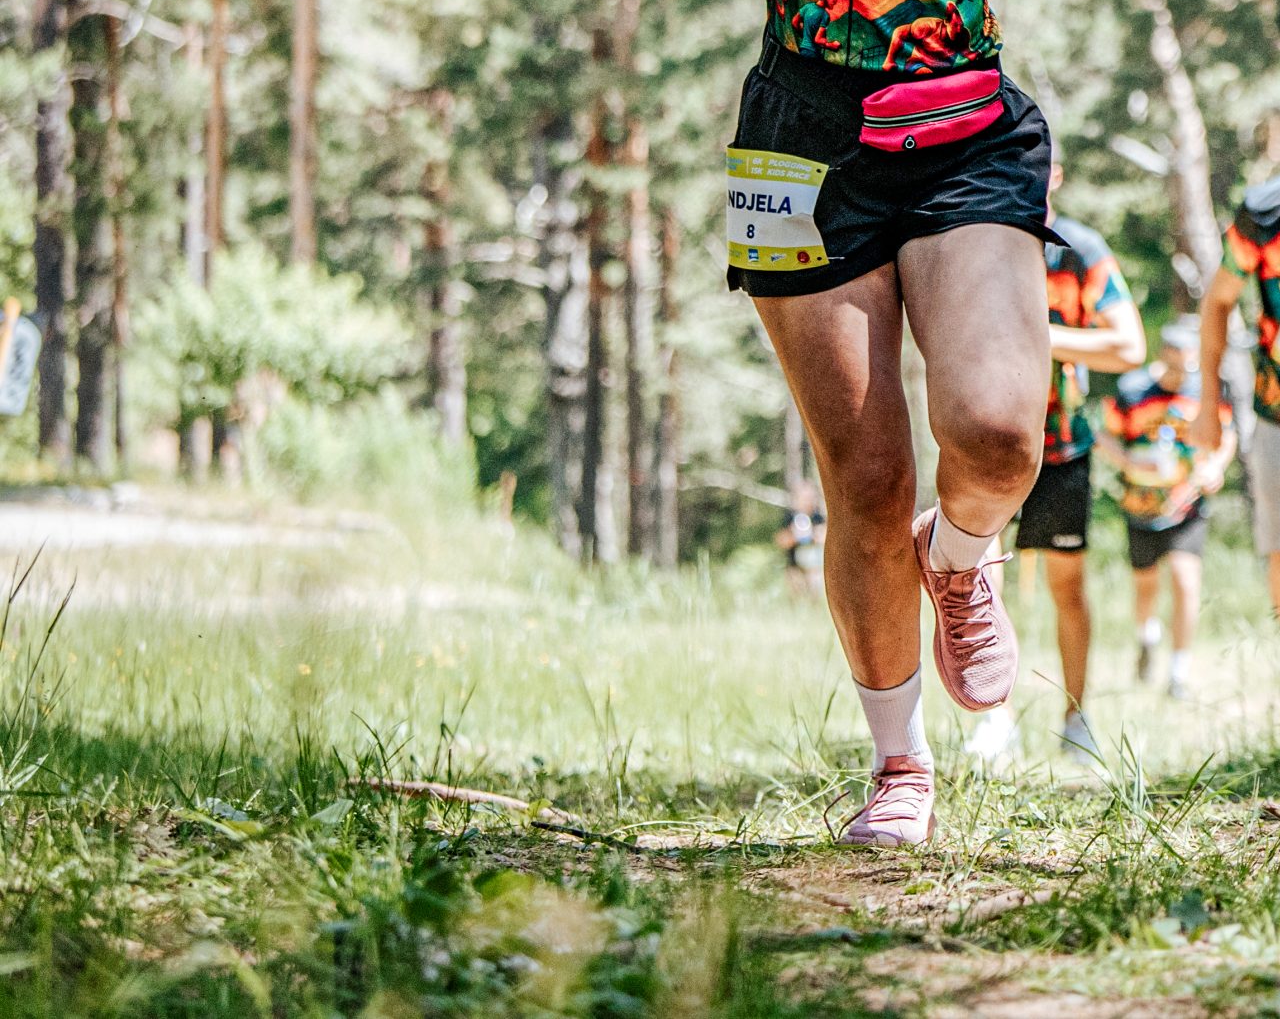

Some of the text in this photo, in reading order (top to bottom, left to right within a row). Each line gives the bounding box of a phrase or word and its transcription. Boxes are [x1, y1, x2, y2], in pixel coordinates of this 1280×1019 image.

[768, 158, 812, 172] PLOGGING
[767, 168, 786, 177] KIDS
[786, 170, 811, 180] RACE
[728, 189, 792, 214] NDJELA
[746, 224, 755, 239] 8
